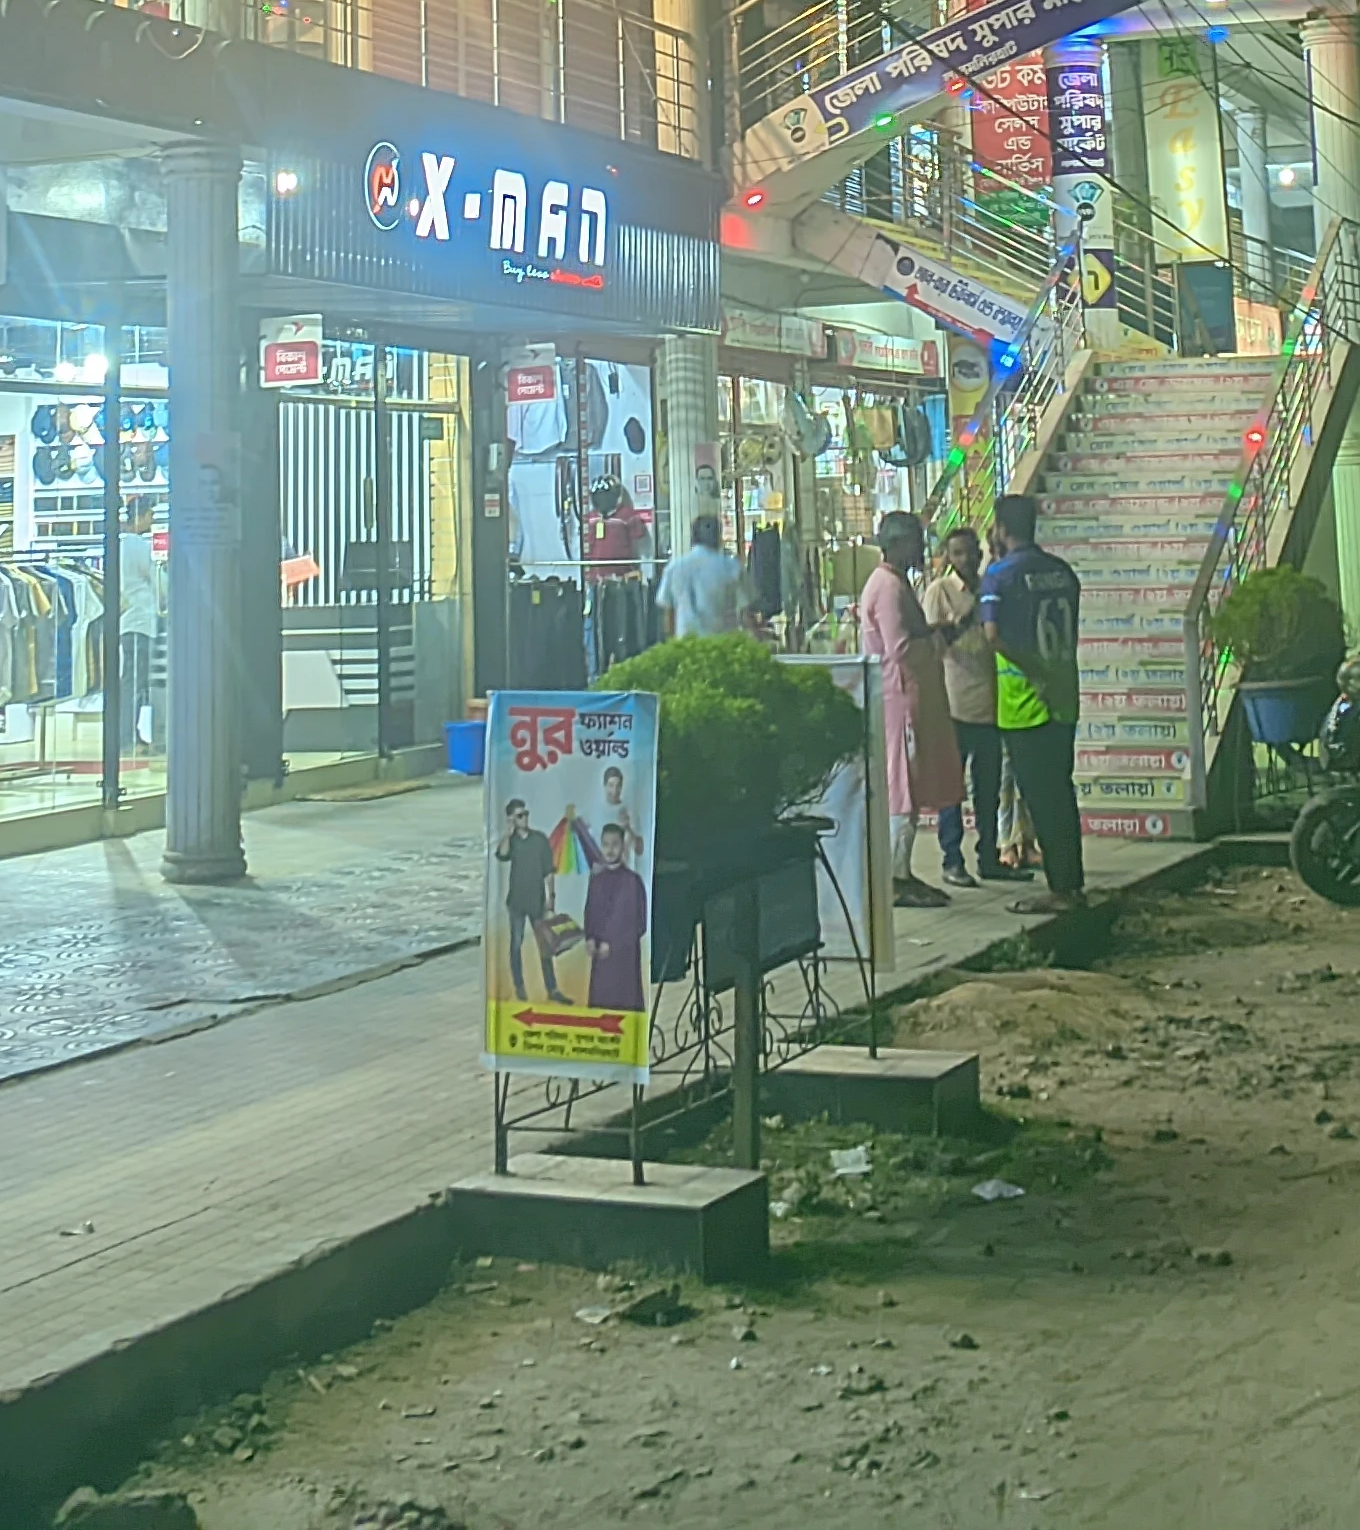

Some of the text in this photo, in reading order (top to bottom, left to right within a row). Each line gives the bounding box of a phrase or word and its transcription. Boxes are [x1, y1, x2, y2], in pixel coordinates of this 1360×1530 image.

[824, 73, 881, 116] জেলা
[884, 37, 967, 81] পরিষদ
[968, 2, 1038, 43] সুপার
[1058, 72, 1099, 90] জেলা
[509, 706, 633, 771] নুর ফ্যাশন
